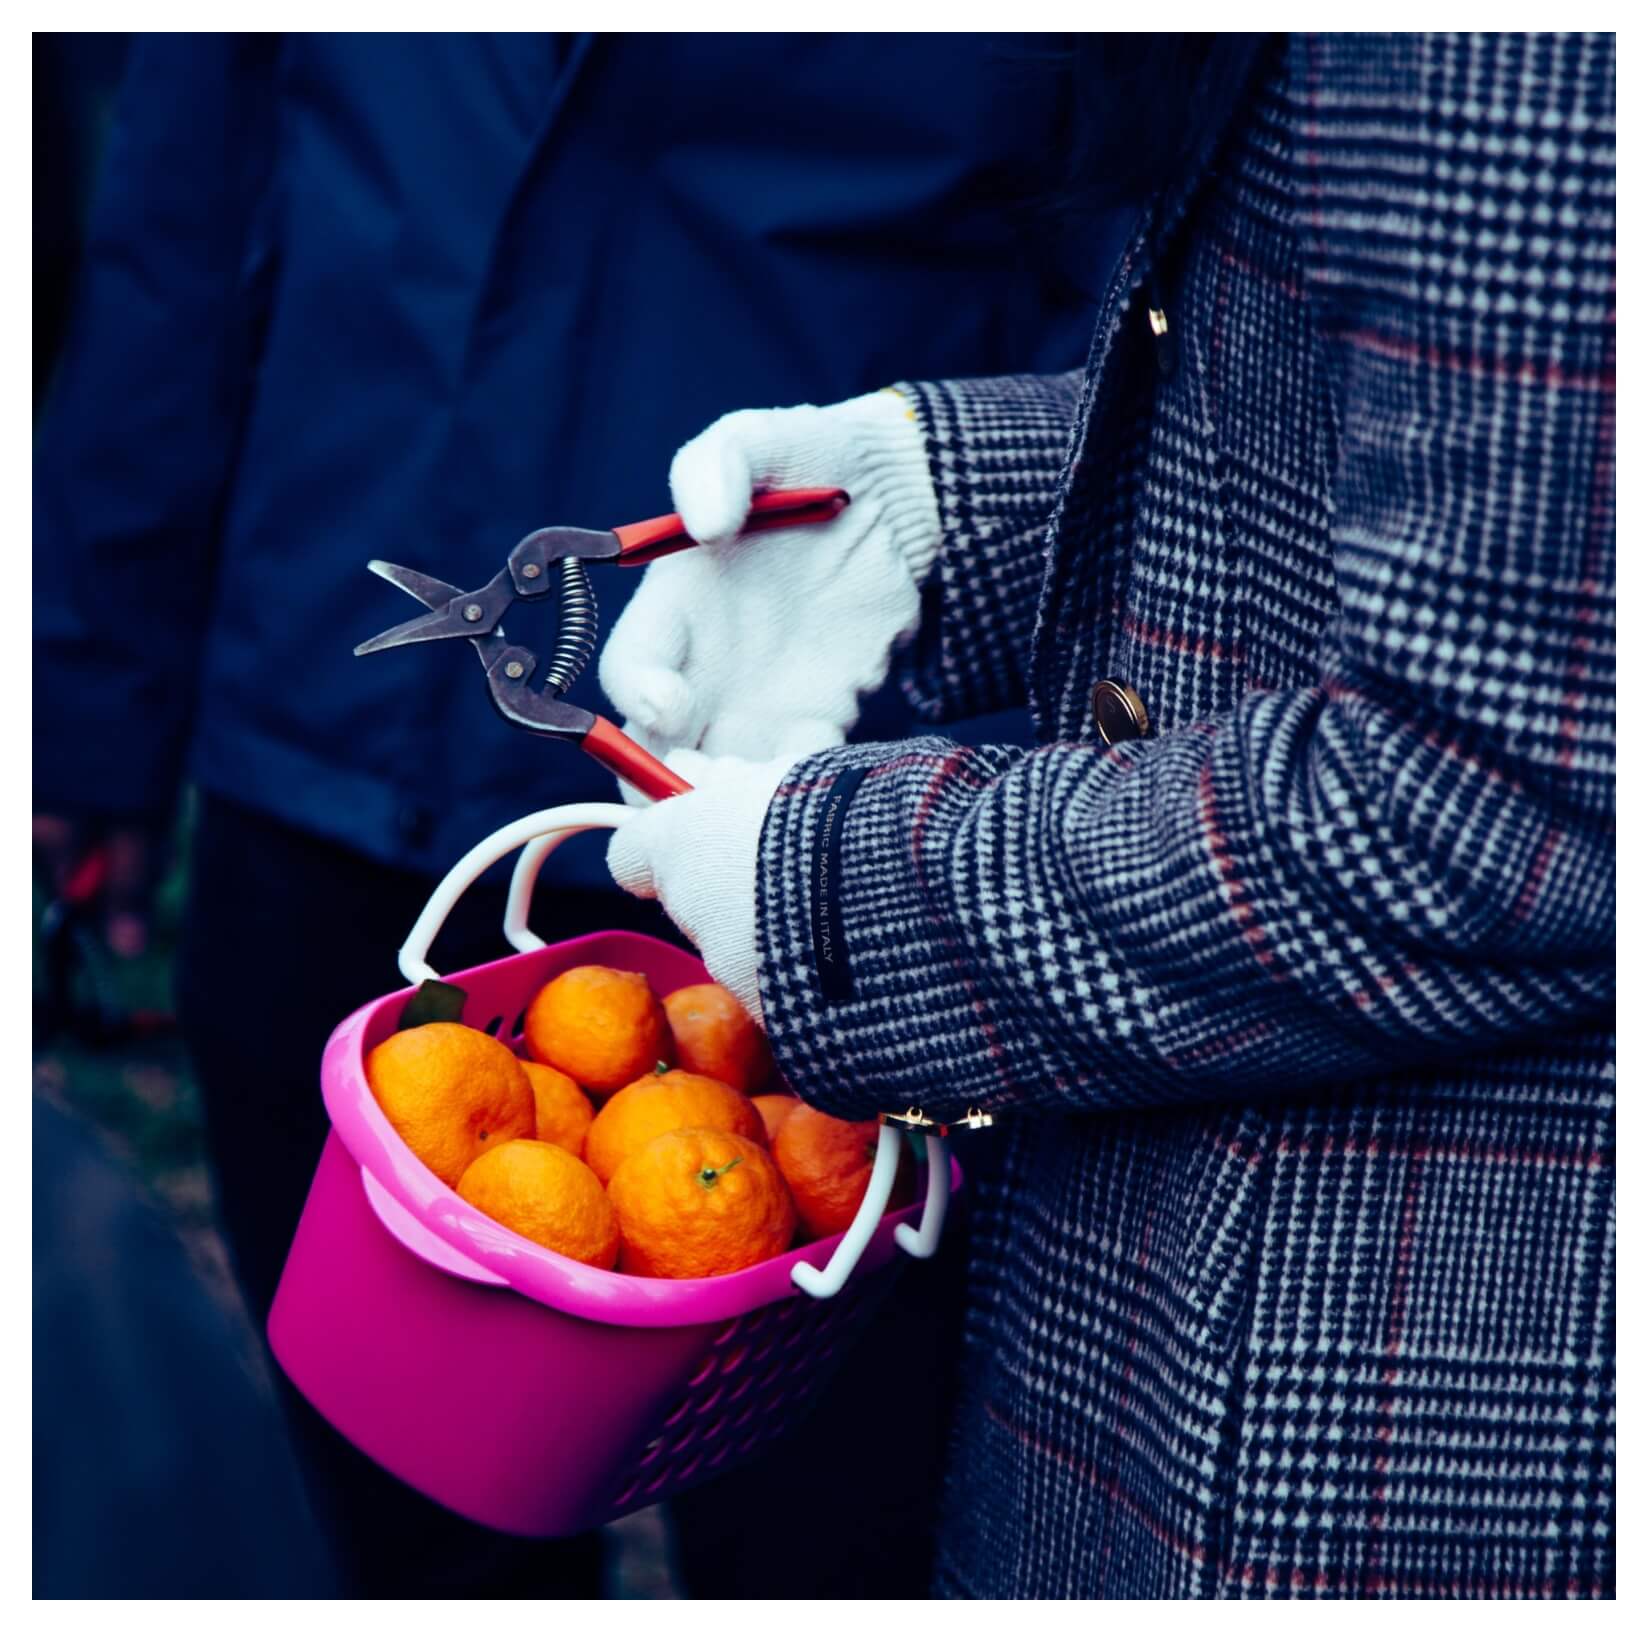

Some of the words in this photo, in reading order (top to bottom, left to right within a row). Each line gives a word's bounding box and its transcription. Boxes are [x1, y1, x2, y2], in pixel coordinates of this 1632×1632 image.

[821, 794, 842, 848] FABRIC
[819, 853, 829, 896] MADE
[819, 901, 828, 918] IN
[820, 921, 833, 964] ITALY
